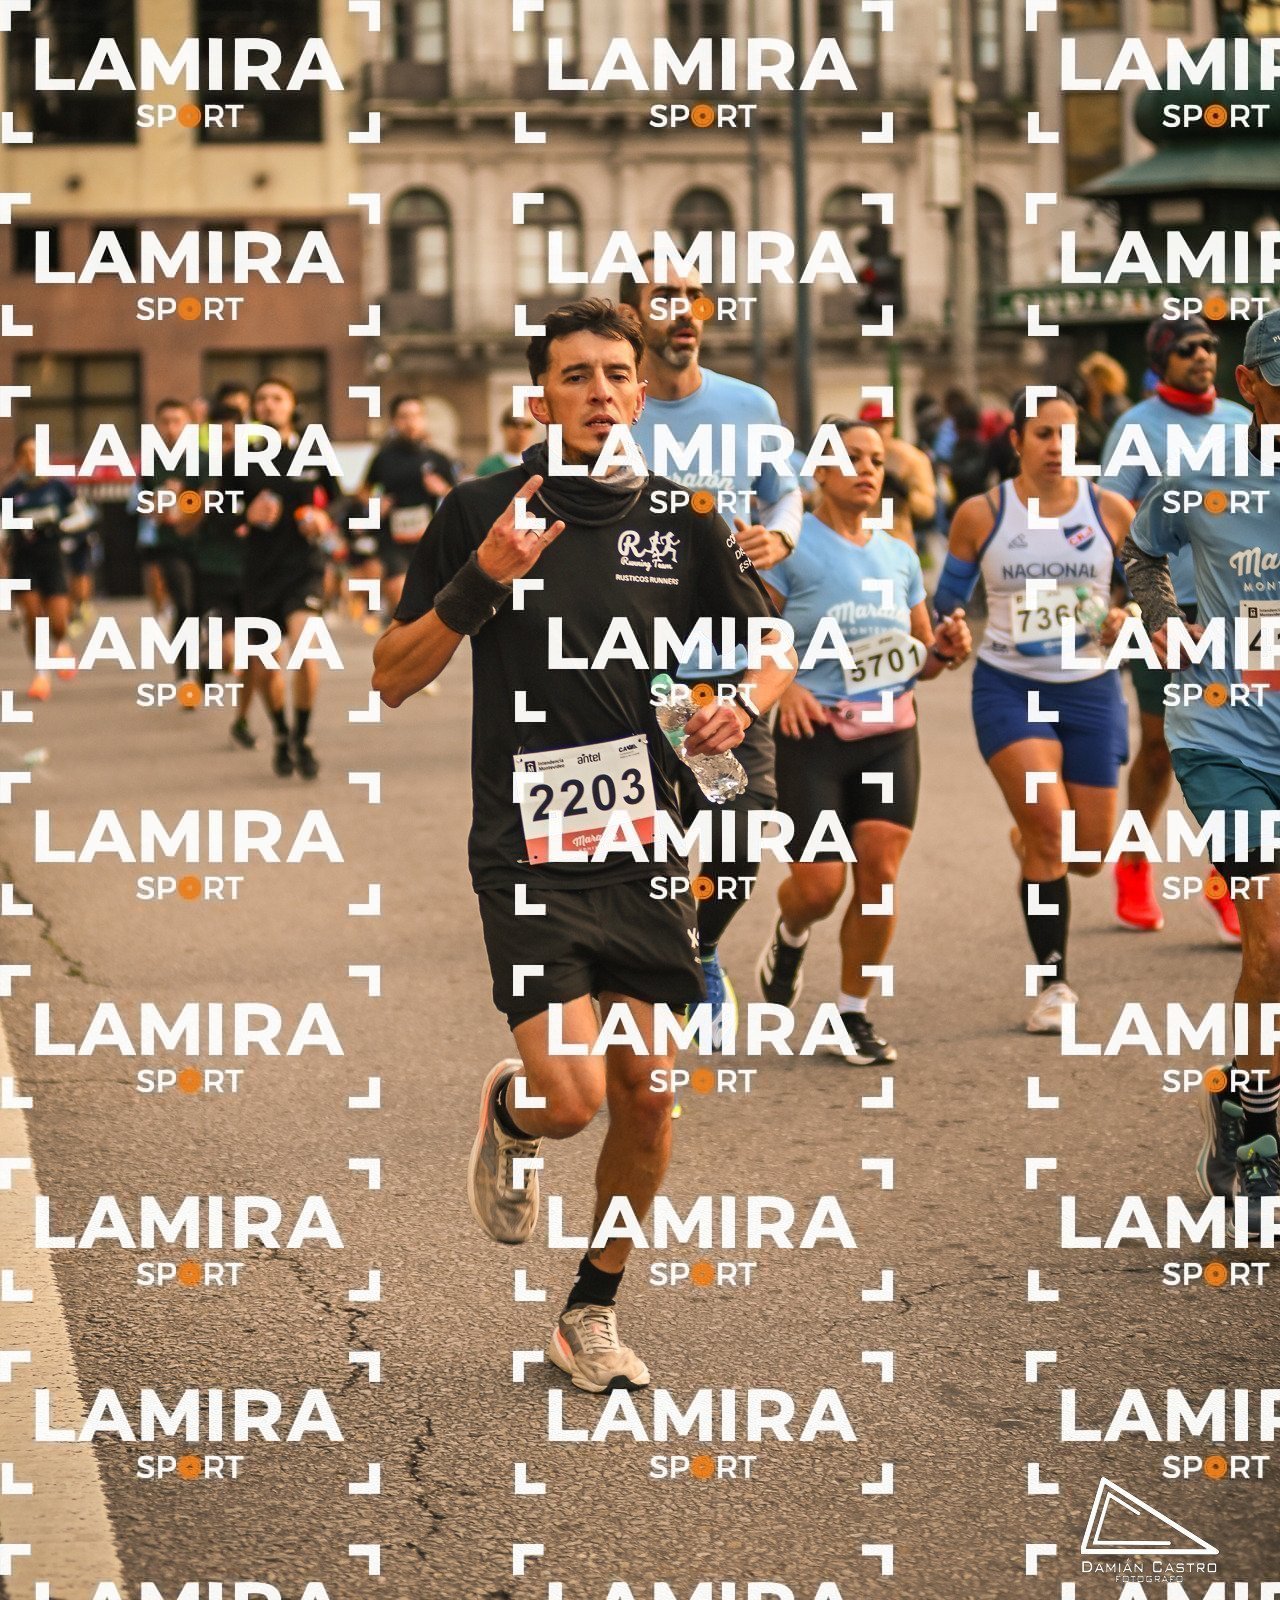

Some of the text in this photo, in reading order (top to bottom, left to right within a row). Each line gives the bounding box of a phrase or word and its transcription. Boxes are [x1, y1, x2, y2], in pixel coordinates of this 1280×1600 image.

[615, 573, 679, 586] RUSTICOS RUNNERS
[1001, 562, 1098, 580] NACIONAL
[851, 644, 921, 683] 5701
[577, 752, 602, 765] antel
[529, 768, 645, 822] 2203
